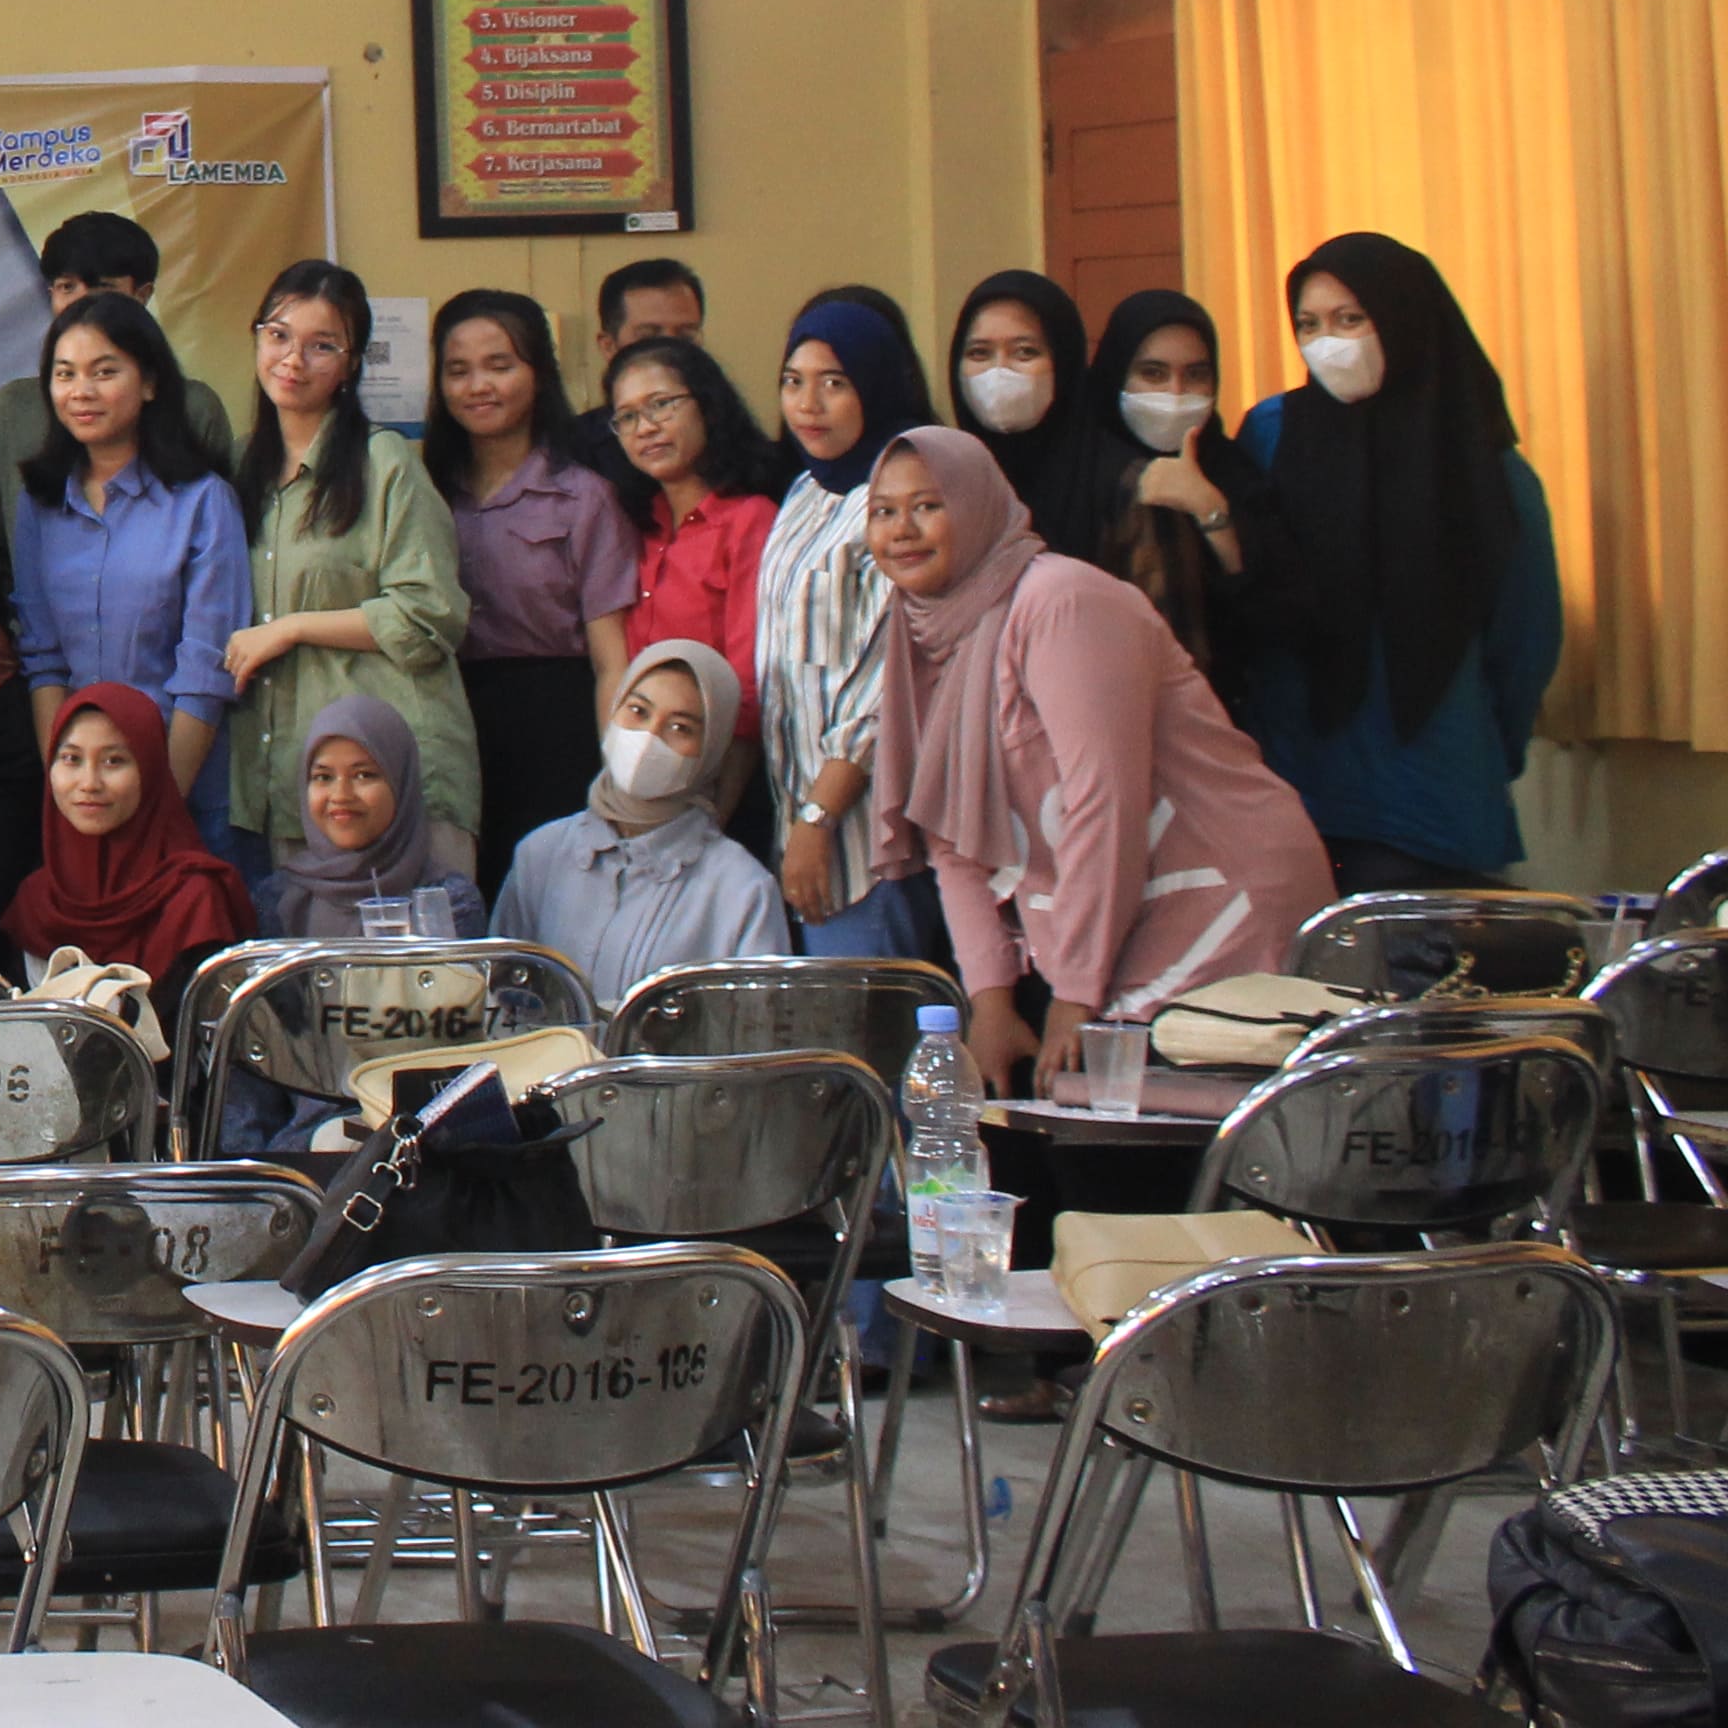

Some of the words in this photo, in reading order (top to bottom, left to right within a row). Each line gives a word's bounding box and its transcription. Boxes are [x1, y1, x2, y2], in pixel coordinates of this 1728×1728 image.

[480, 13, 496, 29] 3.
[503, 12, 578, 27] Visioner
[480, 48, 498, 64] 4.
[504, 47, 593, 68] Bijaksana
[482, 84, 499, 100] 5.
[505, 83, 576, 103] Disiplin
[482, 120, 500, 136] 6.
[507, 118, 621, 136] Bermartabat
[169, 161, 285, 183] LAMEMBA
[484, 156, 501, 172] 7.
[507, 155, 603, 175] Kerjasama
[425, 1342, 707, 1405] FE-2016-106
